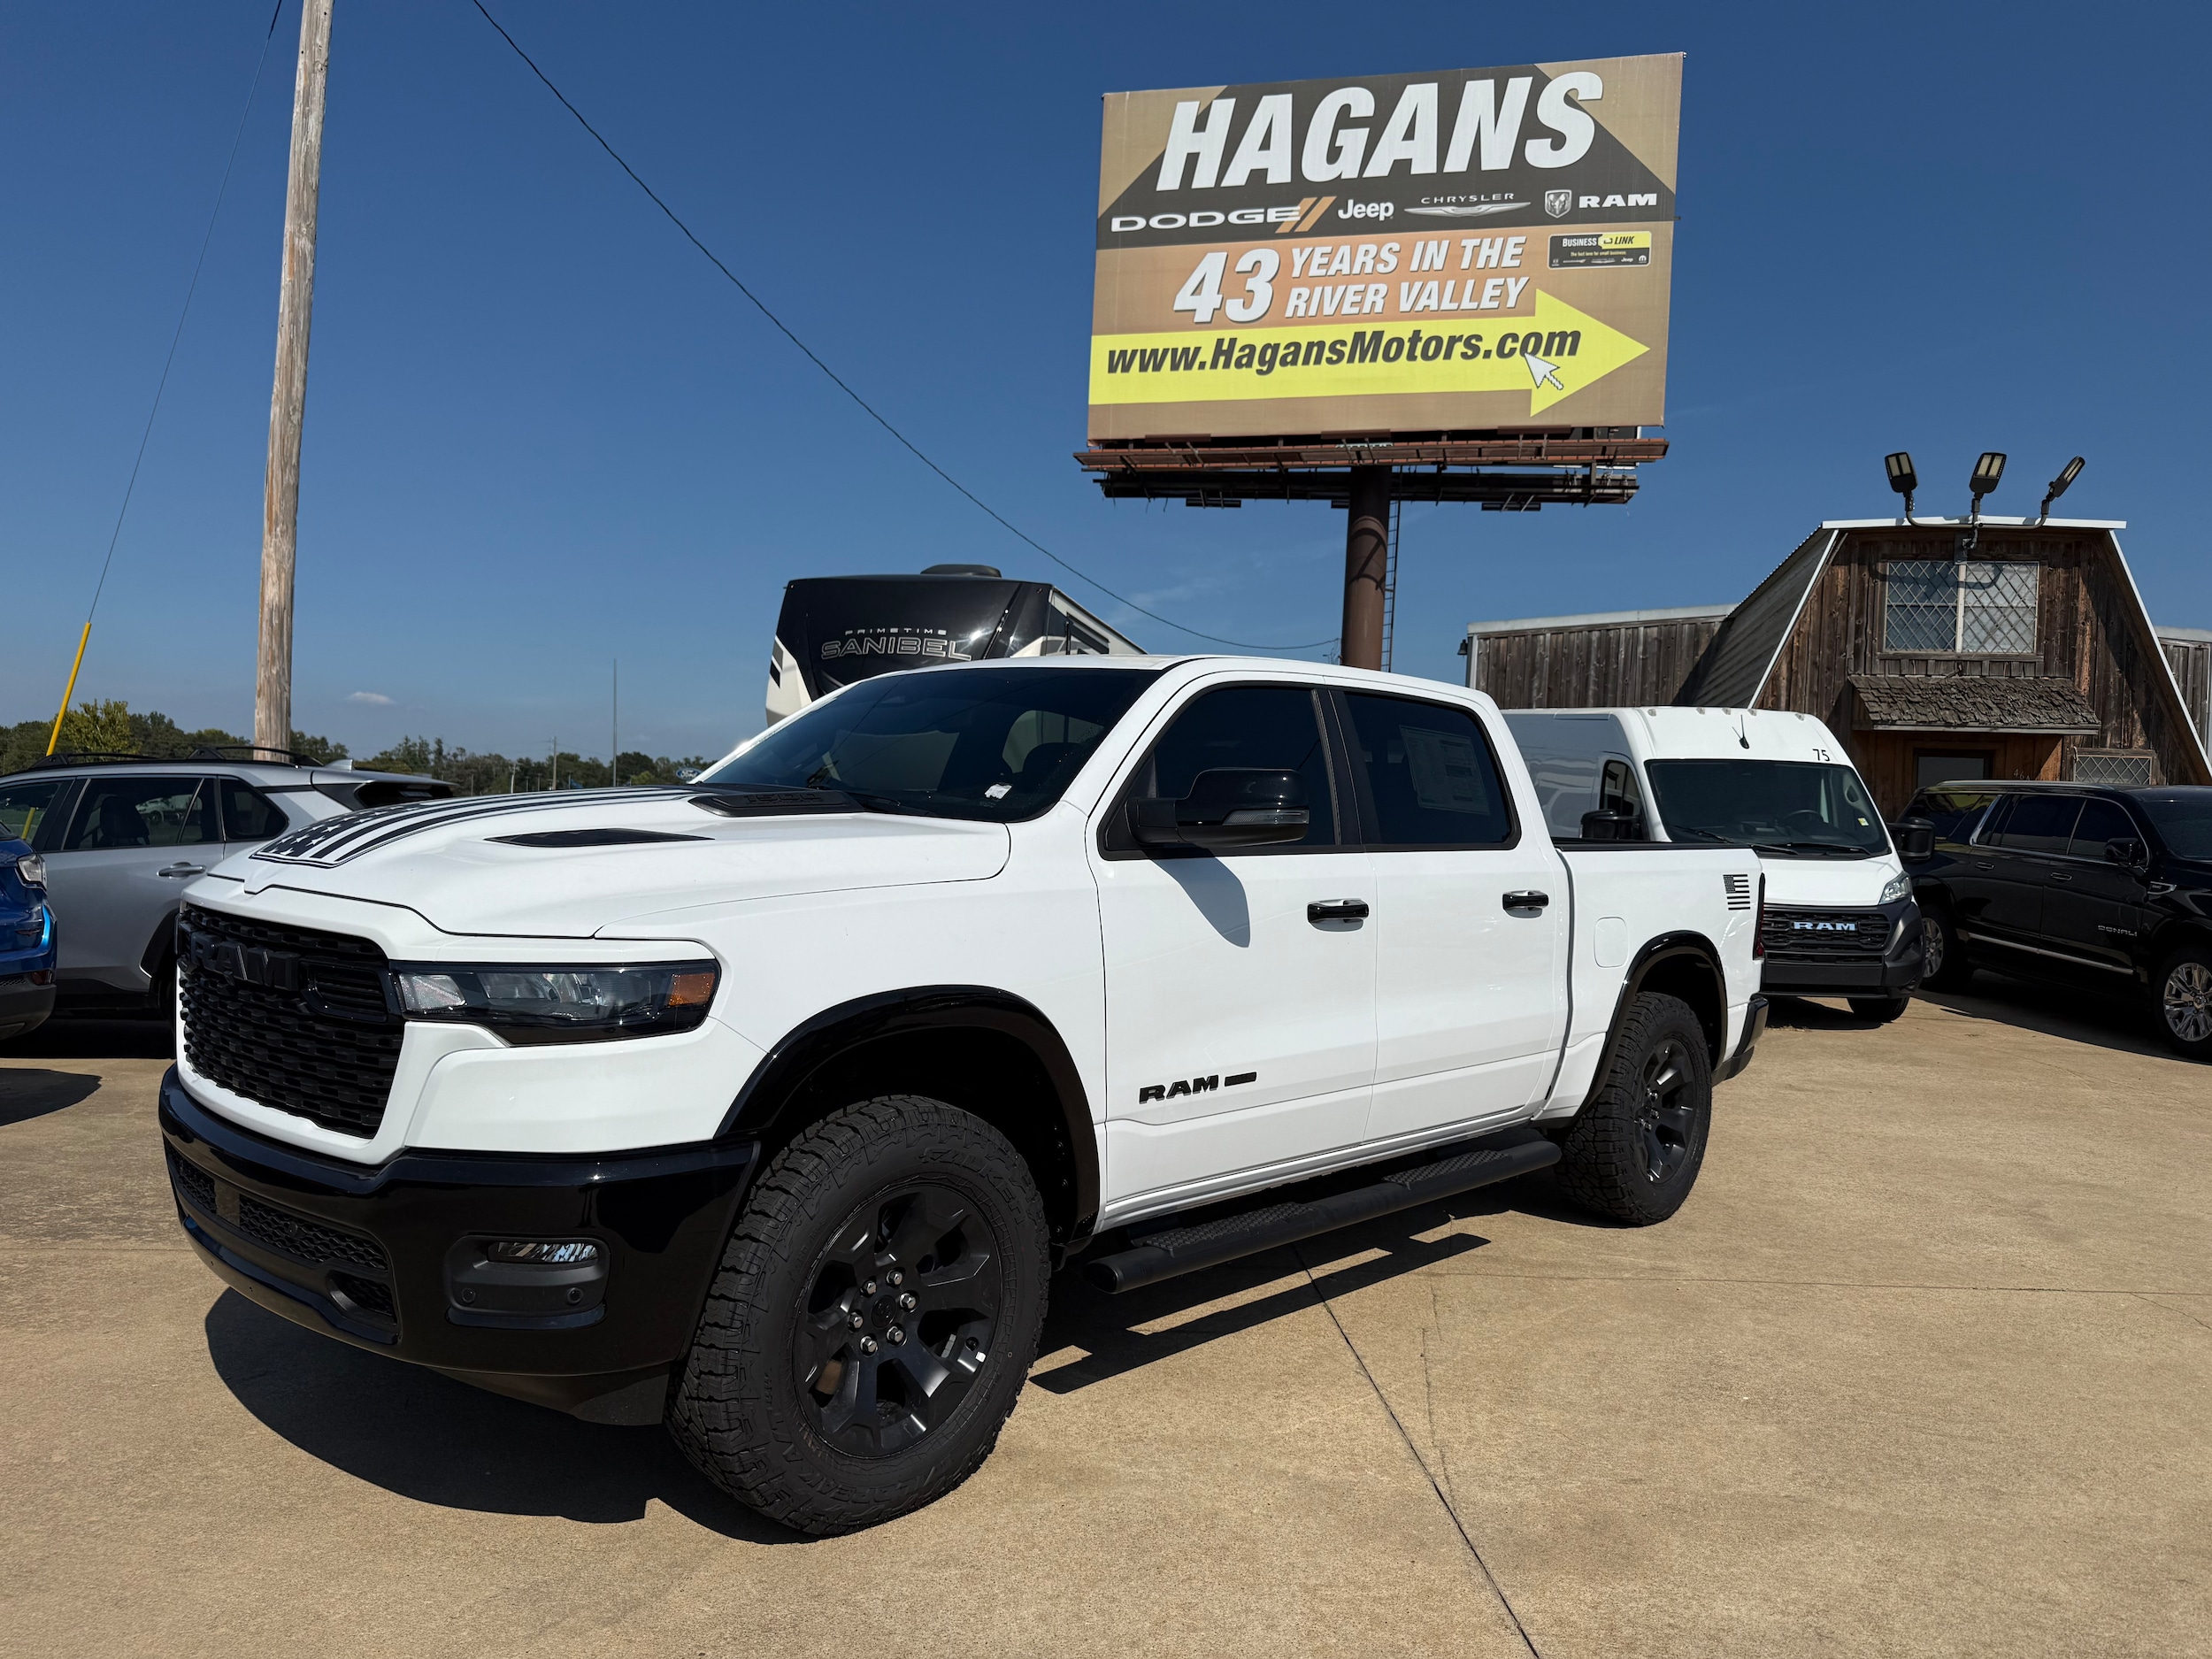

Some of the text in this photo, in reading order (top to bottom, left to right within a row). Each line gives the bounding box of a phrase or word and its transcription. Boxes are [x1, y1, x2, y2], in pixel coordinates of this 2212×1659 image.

[1155, 71, 1603, 192] HAGANS
[1338, 199, 1394, 220] Jeep
[1420, 193, 1515, 204] CHRYSLER
[1578, 193, 1657, 208] RAM
[1111, 206, 1301, 233] DODGE
[1562, 235, 1635, 248] BUSINESS LINK
[1291, 236, 1527, 278] YEARS IN THE
[1172, 248, 1280, 325] 43
[1285, 277, 1531, 319] RIVER VALLEY
[1106, 328, 1582, 376] www.HagansMotors.com
[820, 636, 972, 661] SANIBEL
[1812, 749, 1831, 762] 75
[1793, 921, 1856, 931] RAM
[2097, 925, 2138, 937] DENALI
[190, 931, 301, 992] RAM
[1139, 1074, 1219, 1104] RAM
